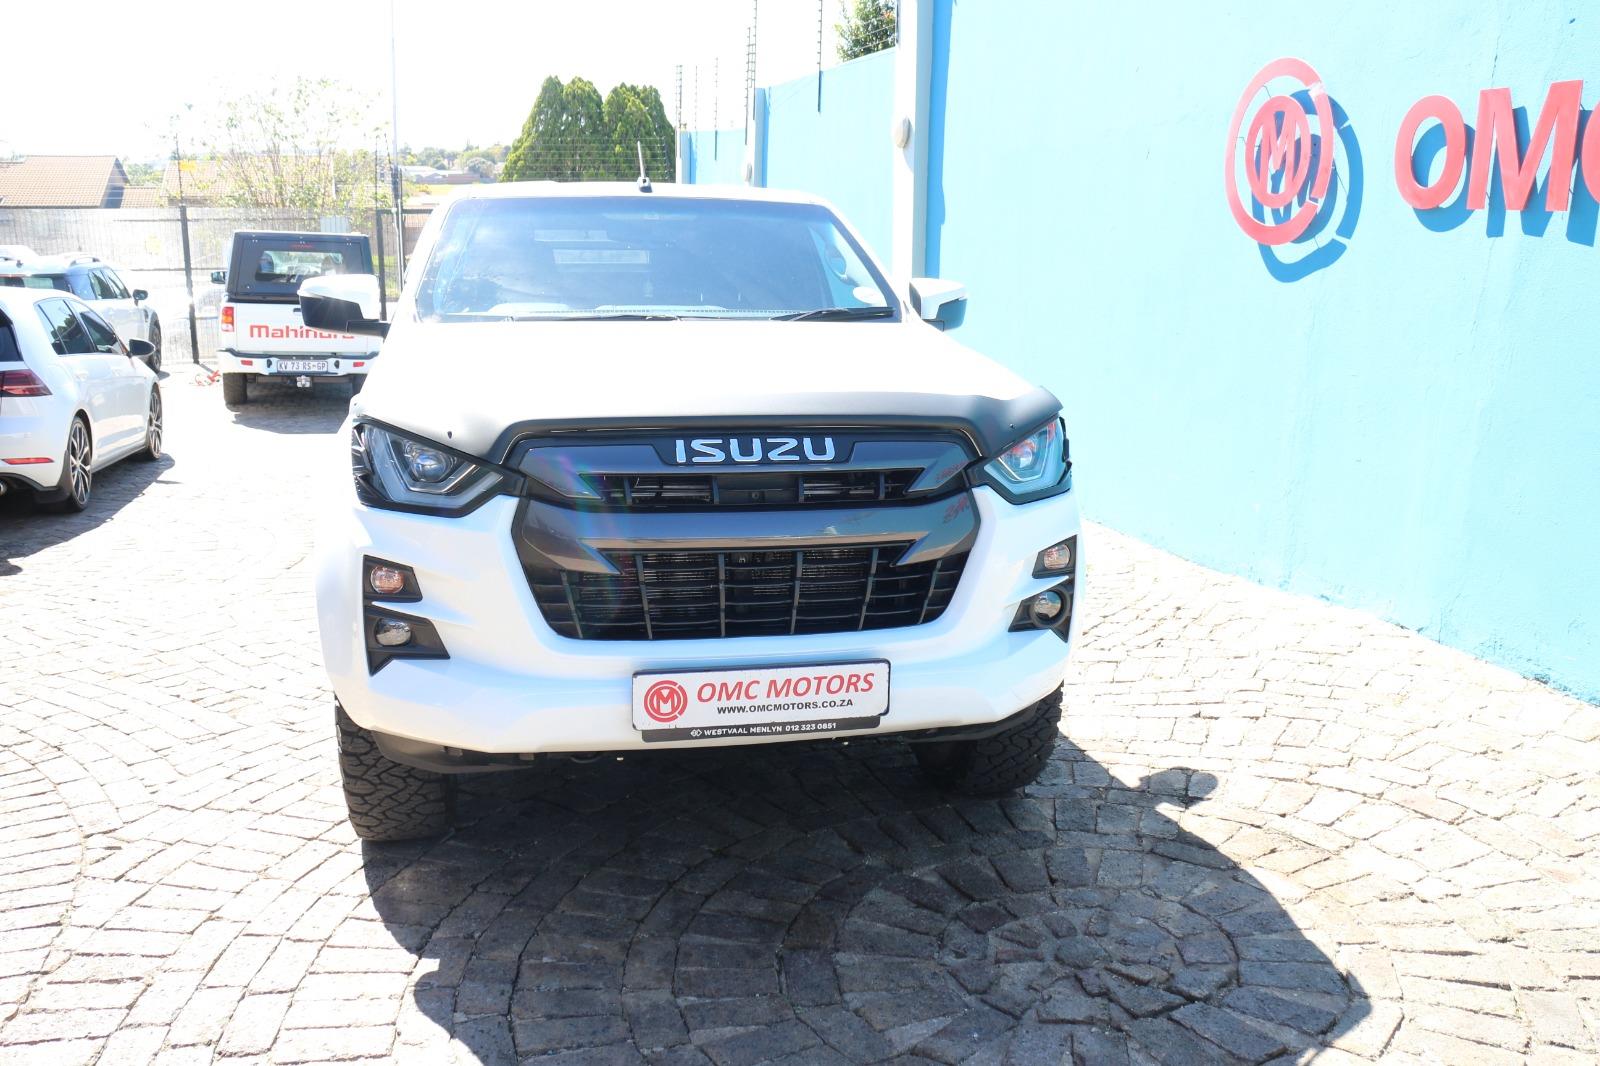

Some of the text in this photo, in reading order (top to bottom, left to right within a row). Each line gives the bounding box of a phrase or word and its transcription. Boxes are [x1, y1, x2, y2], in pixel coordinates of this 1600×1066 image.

[1394, 79, 1600, 212] OM
[291, 361, 300, 370] 73
[675, 437, 836, 463] ISUZU
[696, 672, 875, 703] OMC MOTORS
[717, 698, 854, 715] WWW.OMCMOTORS.CO.ZA
[703, 728, 748, 736] WESTVAAL
[800, 723, 816, 731] 323
[817, 722, 836, 730] 0851
